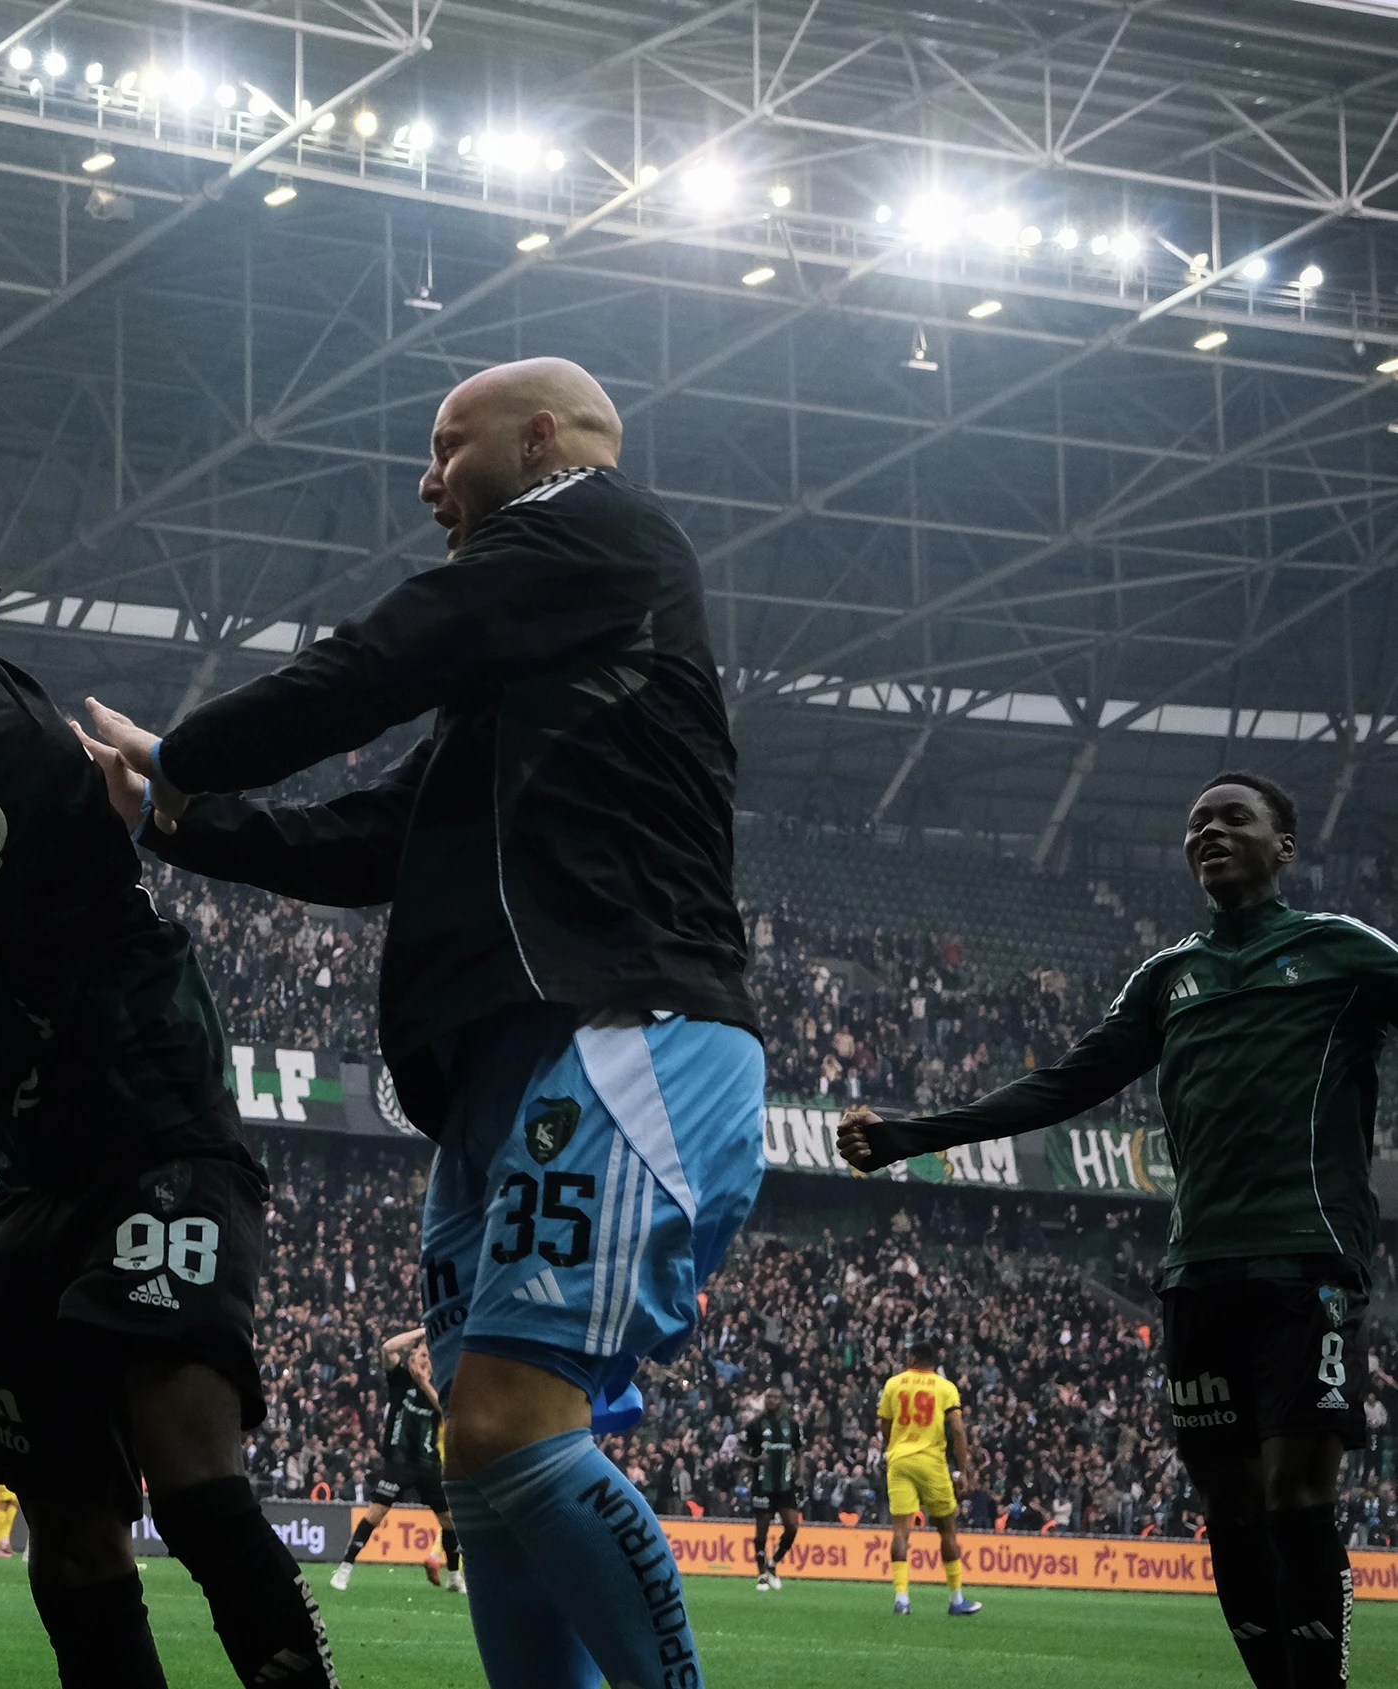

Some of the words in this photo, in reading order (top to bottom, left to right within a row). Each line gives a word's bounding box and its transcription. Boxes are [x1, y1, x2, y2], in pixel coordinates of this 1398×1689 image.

[491, 1171, 595, 1268] 35
[113, 1212, 220, 1286] 98
[128, 1290, 181, 1311] adidas
[1318, 1331, 1346, 1387] 8
[898, 1391, 936, 1428] 19
[979, 1545, 1078, 1579] Dünyası
[1124, 1552, 1196, 1581] Tavuk
